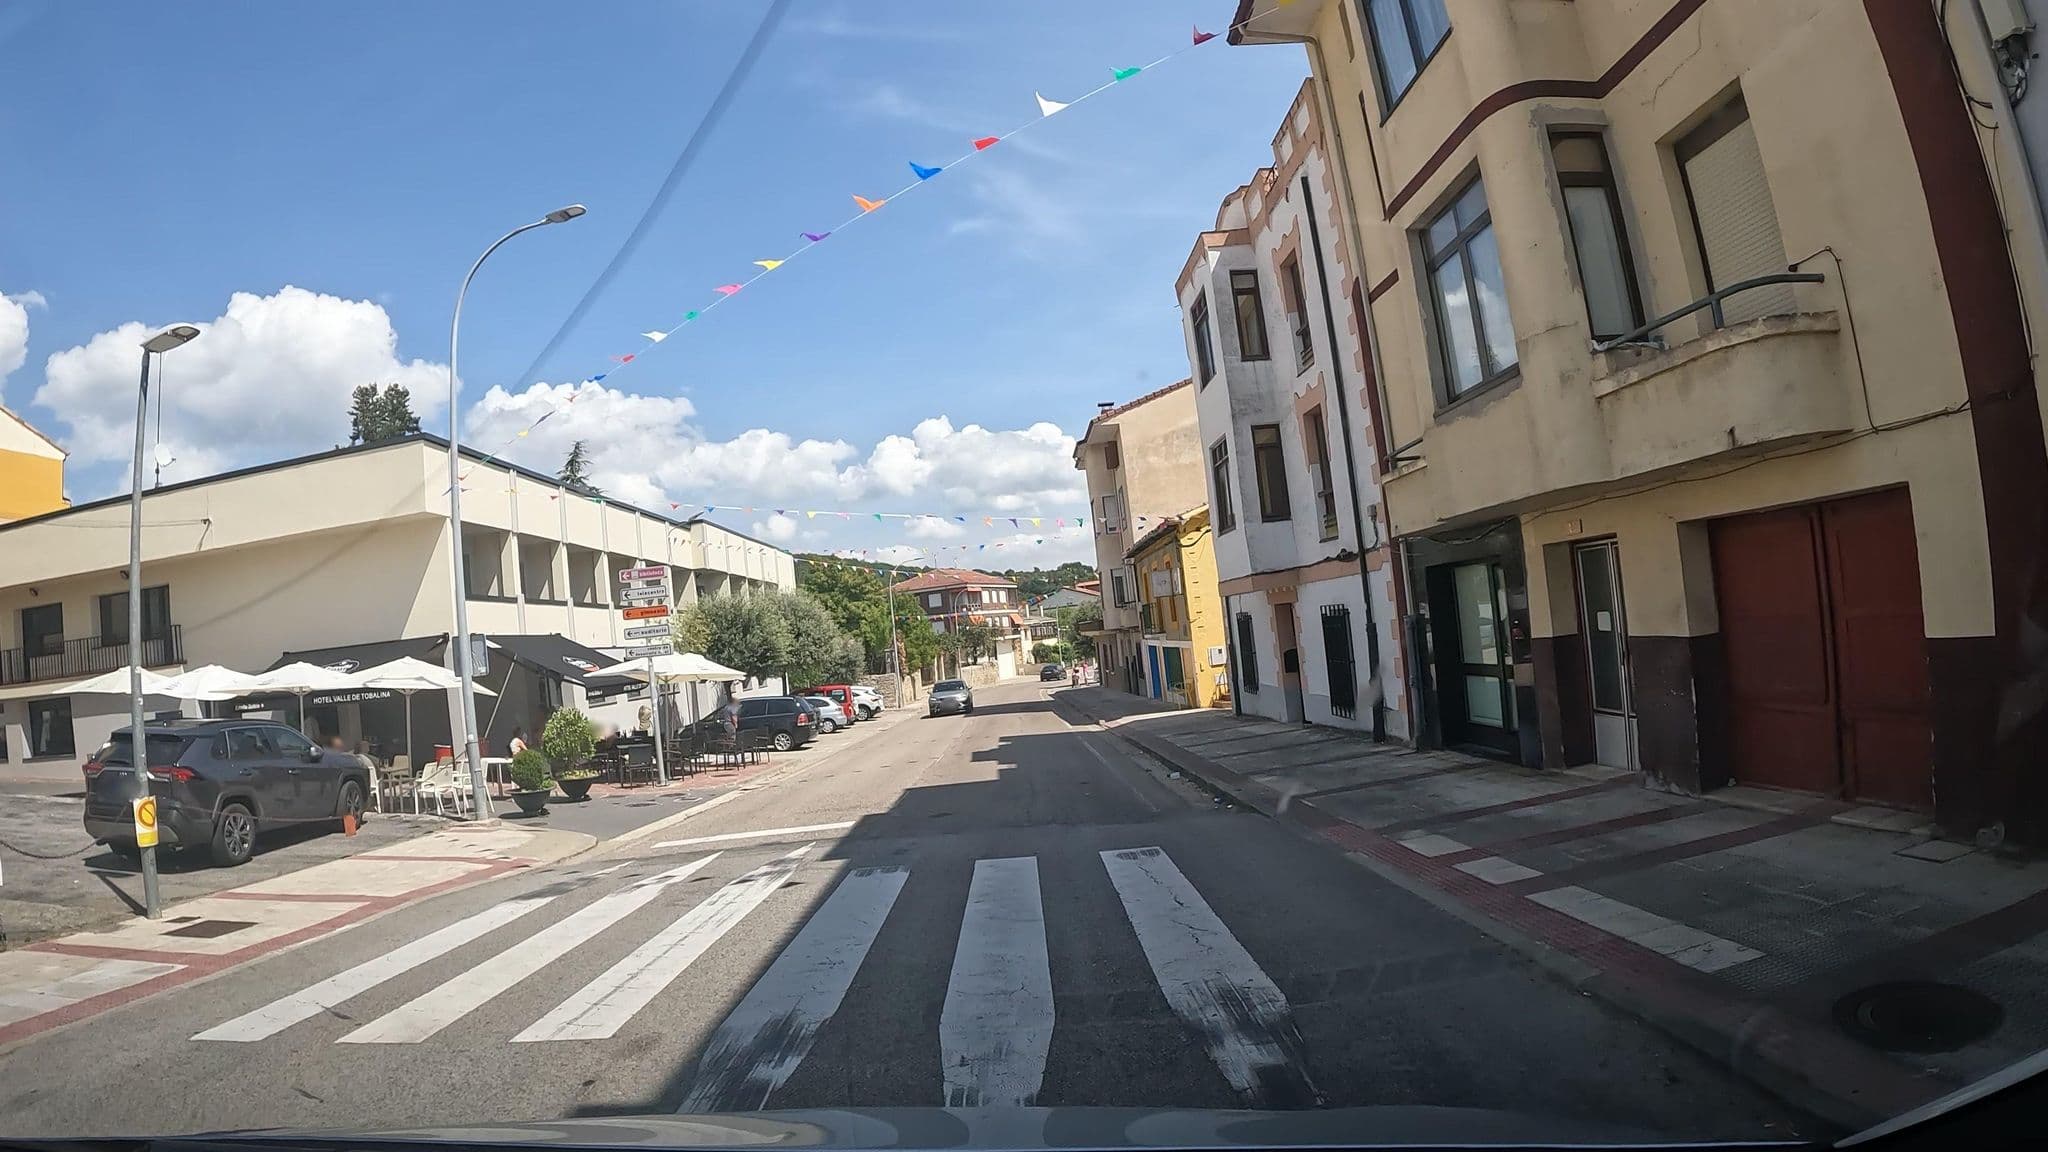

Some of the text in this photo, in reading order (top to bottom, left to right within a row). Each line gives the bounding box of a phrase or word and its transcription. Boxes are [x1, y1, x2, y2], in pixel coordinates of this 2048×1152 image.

[313, 696, 333, 704] HOTEL
[333, 694, 351, 702] VALLE
[361, 691, 391, 699] TOBALINA
